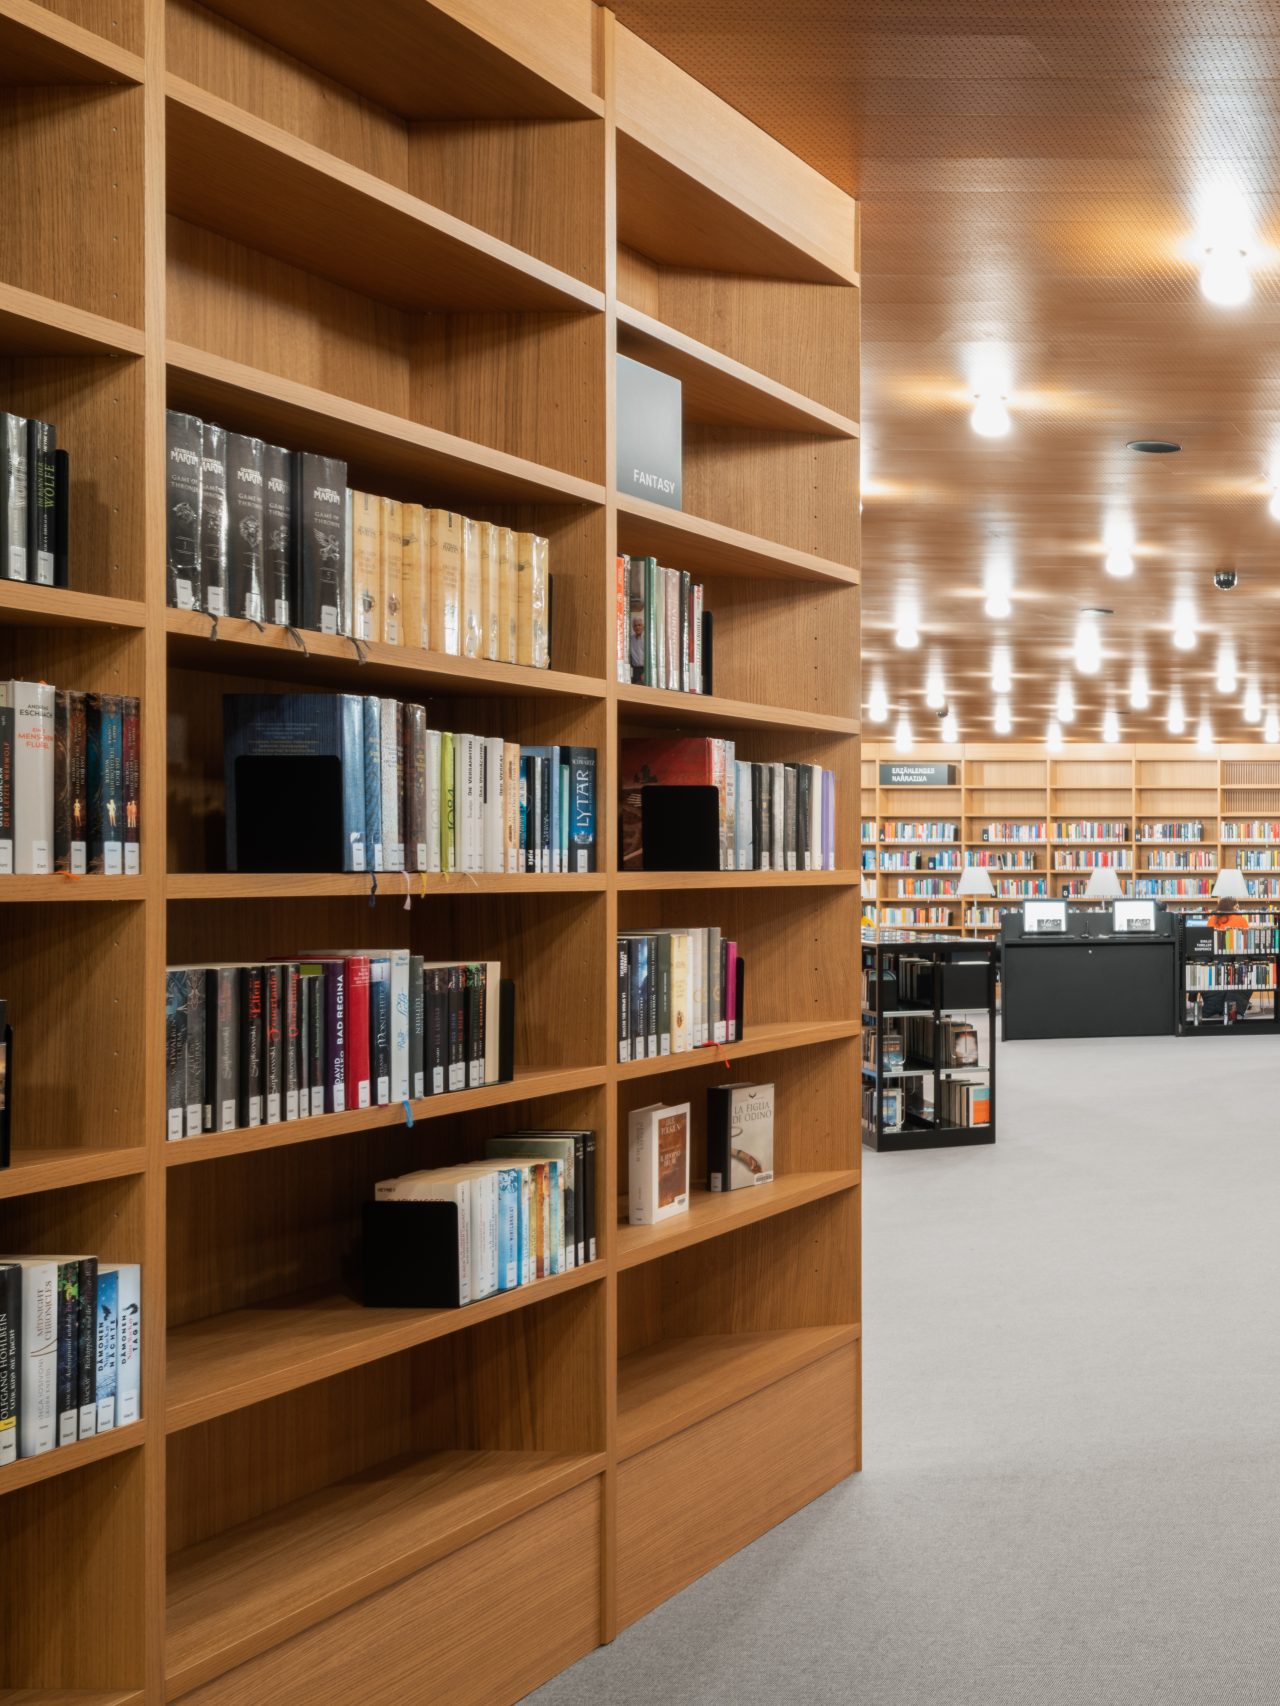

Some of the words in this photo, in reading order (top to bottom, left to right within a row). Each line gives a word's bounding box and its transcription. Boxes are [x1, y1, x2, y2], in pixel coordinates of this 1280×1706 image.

[171, 450, 199, 467] MARTIN
[237, 471, 262, 487] MARTIN
[633, 469, 676, 494] FANTASY
[314, 490, 340, 505] MARTIN
[19, 709, 53, 718] ESCHACH
[336, 974, 344, 1018] REGINA
[336, 1021, 344, 1045] BAD
[250, 1025, 259, 1078] Sapkowski
[734, 1106, 743, 1114] LA
[746, 1101, 771, 1113] FIGLIA
[744, 1110, 772, 1122] ODINO
[44, 1280, 52, 1341] CHRONICLES
[0, 1370, 8, 1420] OLFGANG
